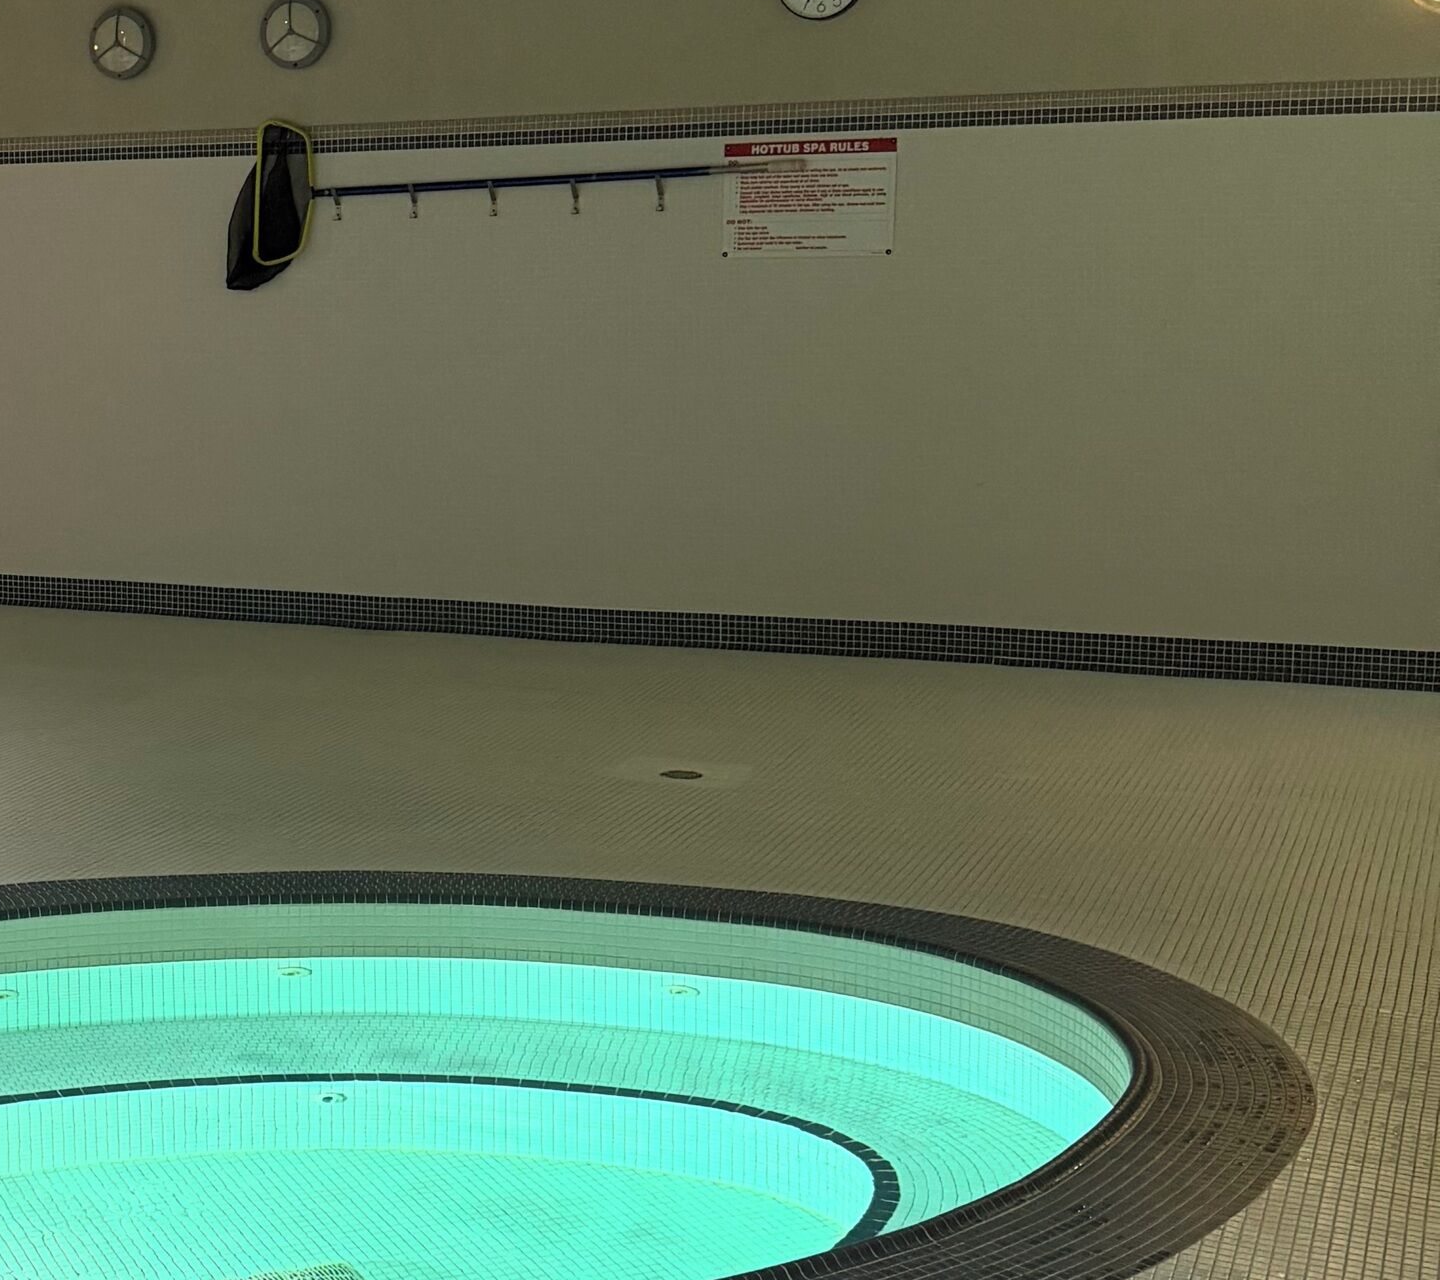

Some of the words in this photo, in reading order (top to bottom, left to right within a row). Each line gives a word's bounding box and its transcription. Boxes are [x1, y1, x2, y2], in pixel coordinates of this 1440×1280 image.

[817, 0, 826, 13] 6
[751, 144, 799, 155] HOTTUB
[803, 143, 826, 153] SPA
[830, 141, 869, 152] RULES
